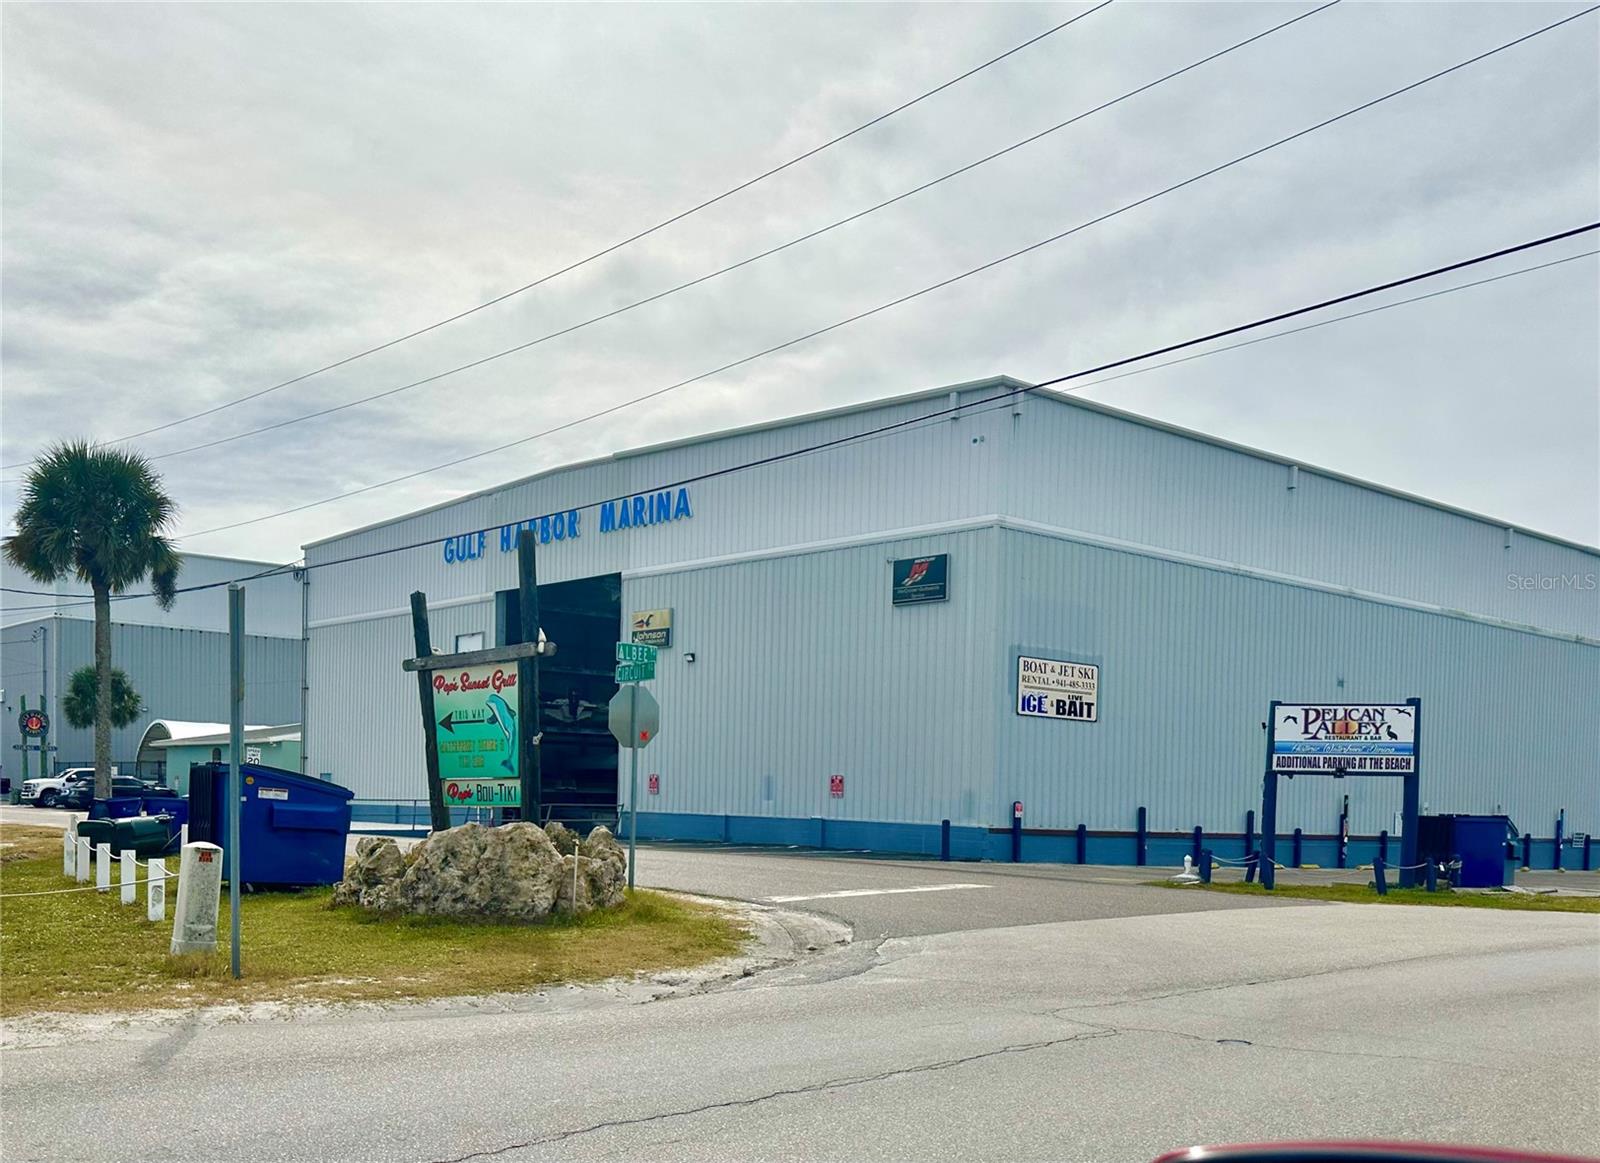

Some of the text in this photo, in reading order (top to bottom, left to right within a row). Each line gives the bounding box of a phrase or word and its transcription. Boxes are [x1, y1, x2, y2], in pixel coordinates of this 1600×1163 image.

[444, 531, 486, 564] GULF
[600, 488, 692, 533] MARINA
[632, 631, 666, 642] Johnson
[618, 645, 648, 662] ALBEE
[617, 665, 646, 680] CIRCUIT
[1023, 660, 1094, 680] BOAT & JET SKI
[460, 672, 490, 692] Sunset
[492, 669, 517, 693] Grill
[1022, 674, 1095, 690] RENTAL 941-485-3333
[454, 708, 485, 720] THIS WAY
[1021, 693, 1048, 714] ICE
[1056, 699, 1094, 718] BAIT
[1301, 707, 1386, 734] PELICAN
[1304, 721, 1388, 740] ALLEY
[247, 756, 259, 765] 20
[1276, 756, 1411, 770] ADDITIONAL PARKING AT THE BEACH
